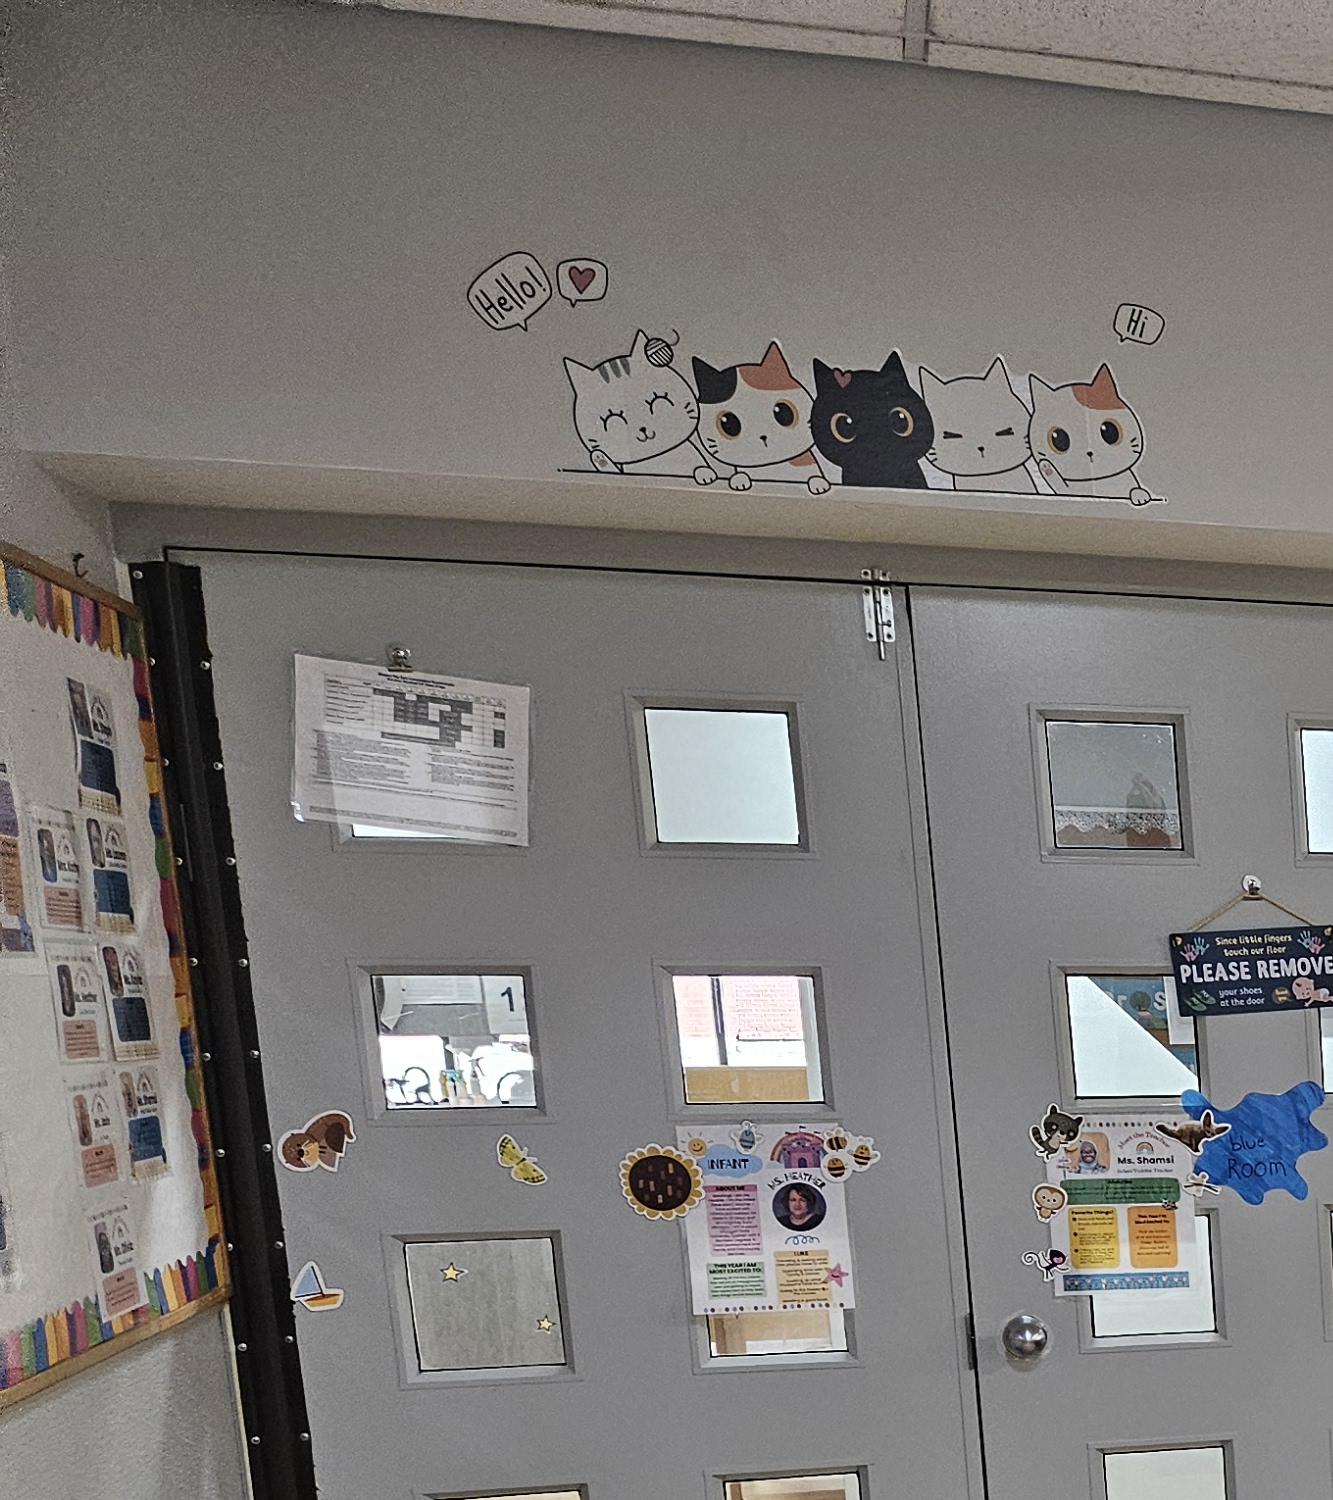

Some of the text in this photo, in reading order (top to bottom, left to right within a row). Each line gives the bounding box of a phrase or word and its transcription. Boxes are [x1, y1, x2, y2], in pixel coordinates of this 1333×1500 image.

[475, 266, 546, 325] Hello!
[1126, 308, 1149, 336] Hi
[1215, 932, 1293, 946] Since little fingers
[1223, 945, 1287, 957] touch our floor
[1179, 961, 1252, 984] PLEASE
[501, 986, 515, 1012] 1
[1218, 986, 1263, 997] your shoes
[1220, 997, 1266, 1007] at the door
[1229, 1134, 1266, 1152] blue
[707, 1158, 749, 1170] INFANT
[1117, 1155, 1175, 1165] Ms. Shamsi
[1227, 1158, 1287, 1179] Room
